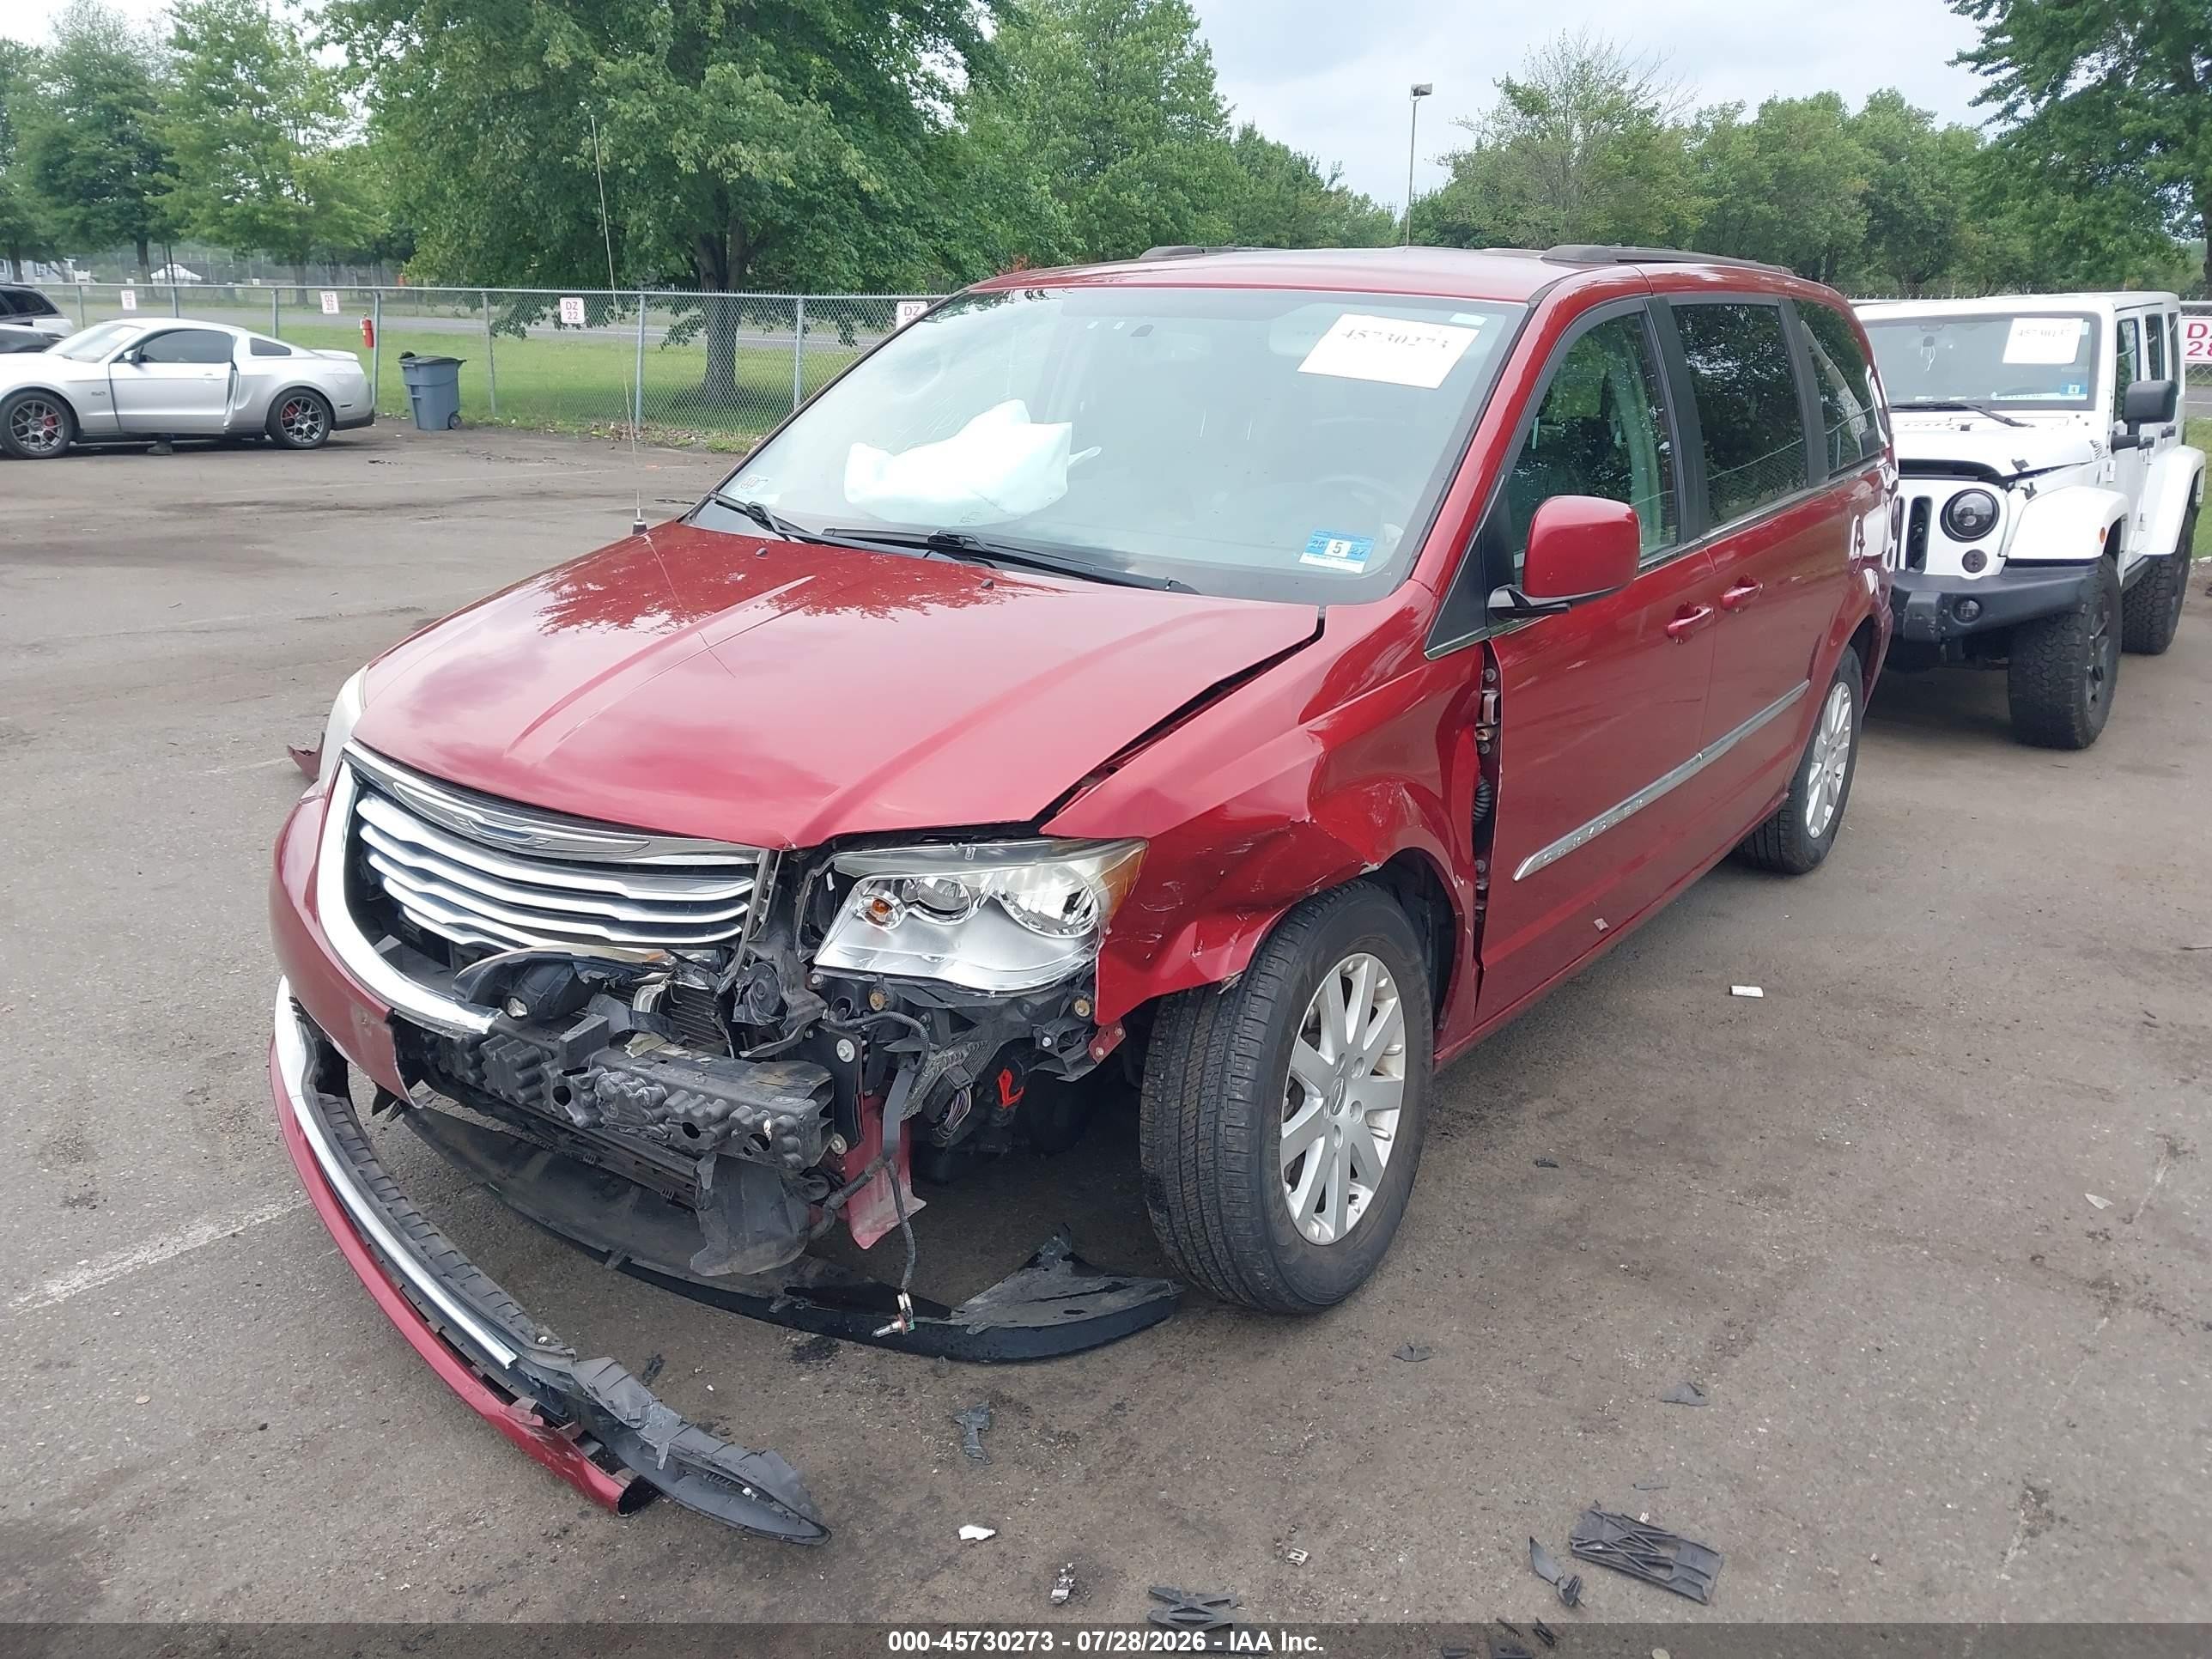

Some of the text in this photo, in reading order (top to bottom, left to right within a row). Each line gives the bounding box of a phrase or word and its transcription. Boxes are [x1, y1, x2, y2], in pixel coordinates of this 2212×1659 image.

[565, 301, 578, 310] DZ
[567, 311, 578, 320] 22
[904, 306, 921, 316] DZ
[2187, 323, 2212, 339] D
[1333, 542, 1344, 554] 5
